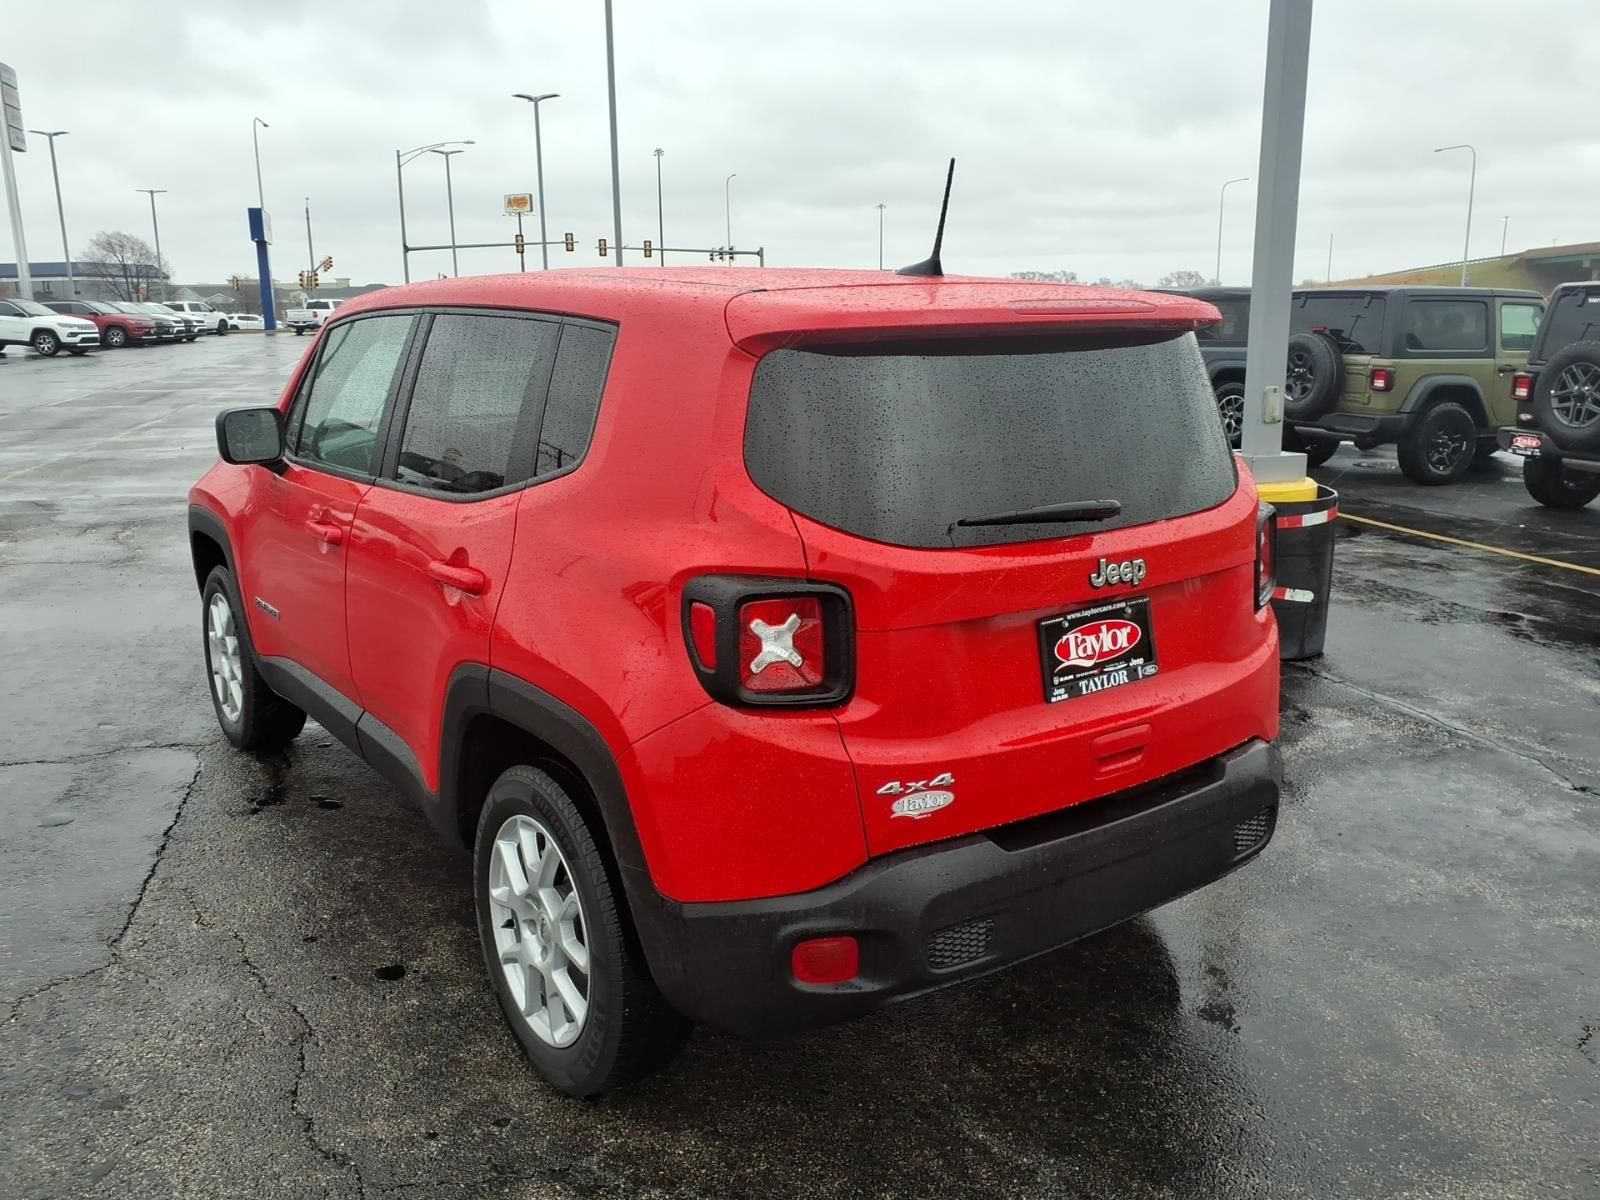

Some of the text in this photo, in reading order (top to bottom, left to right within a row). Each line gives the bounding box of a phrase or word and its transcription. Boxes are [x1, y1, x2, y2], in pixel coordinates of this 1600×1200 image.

[1091, 559, 1146, 587] Jeep
[1066, 602, 1127, 620] www.taylorcars.com
[1057, 624, 1132, 671] Taylor
[1079, 670, 1129, 695] TAYLOR
[895, 793, 948, 815] Taylor
